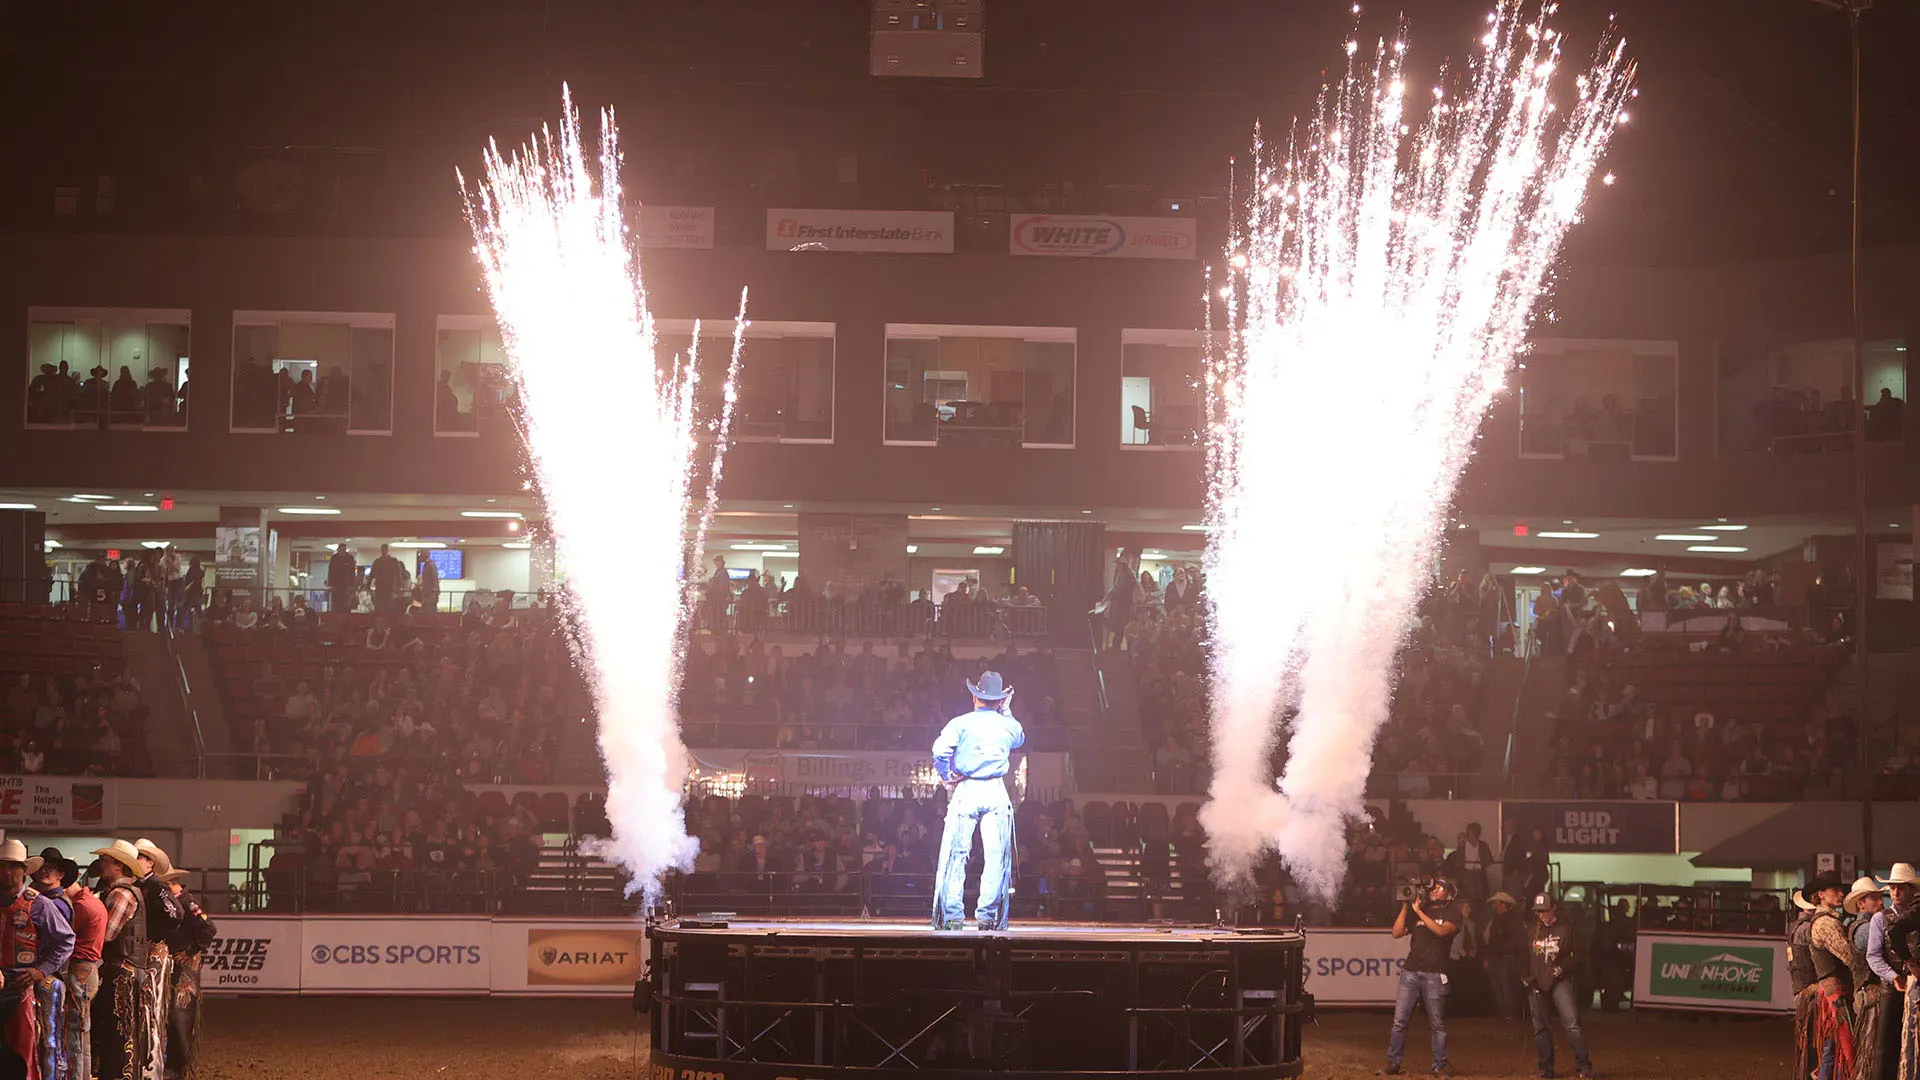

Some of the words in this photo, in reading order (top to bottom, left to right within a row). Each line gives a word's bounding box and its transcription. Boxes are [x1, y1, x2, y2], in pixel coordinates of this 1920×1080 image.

[797, 225, 833, 239] First
[836, 226, 911, 241] Interstate
[912, 227, 944, 242] Bank
[1032, 227, 1112, 245] WHITE
[97, 589, 106, 601] 5
[798, 757, 875, 780] Billings
[0, 777, 23, 787] HTS
[35, 785, 50, 794] The
[0, 789, 24, 815] E
[33, 795, 64, 805] Helpful
[1565, 811, 1612, 828] BUD
[1556, 828, 1620, 845] LIGHT
[200, 939, 272, 956] RIDE
[332, 944, 380, 965] CBS
[385, 944, 481, 965] SPORTS
[200, 956, 266, 971] PASS
[557, 951, 629, 965] ARIAT
[1661, 962, 1764, 984] UNINHOME
